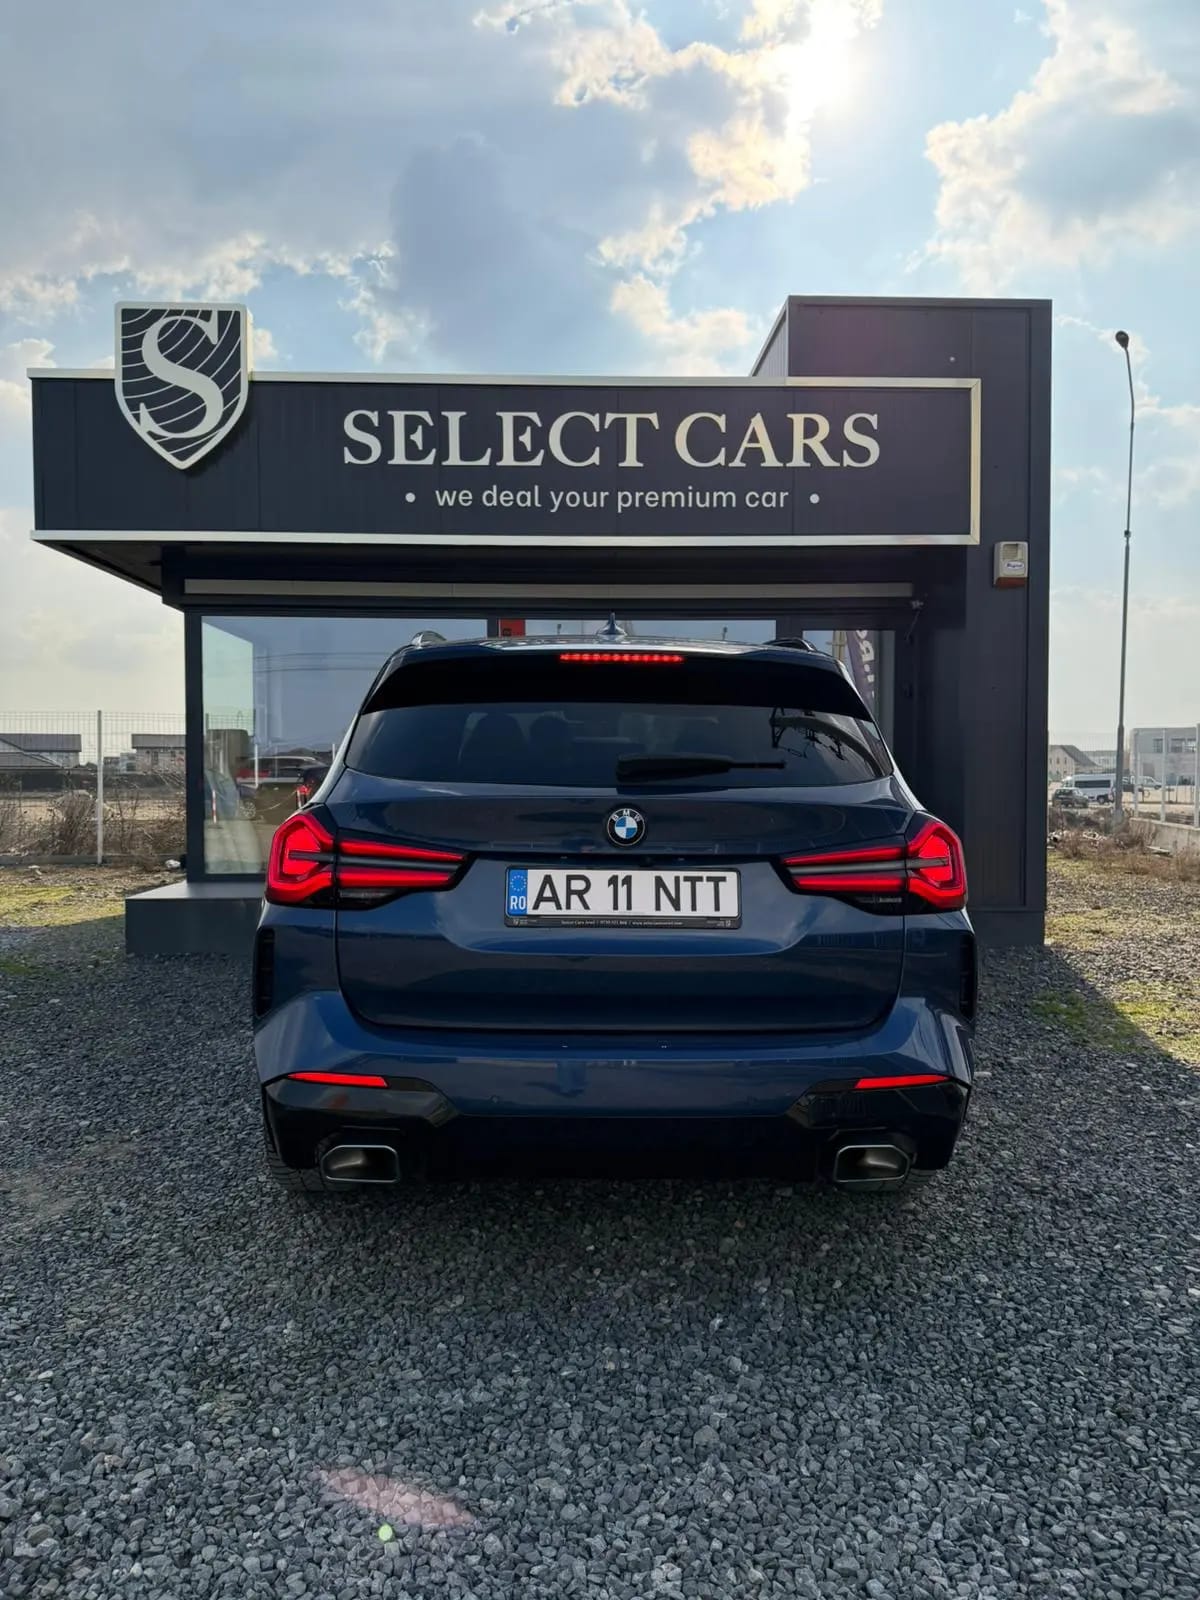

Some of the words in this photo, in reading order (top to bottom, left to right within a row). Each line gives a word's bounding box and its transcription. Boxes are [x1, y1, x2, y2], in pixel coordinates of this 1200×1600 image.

[140, 309, 224, 438] S
[343, 410, 659, 467] SELECT
[675, 412, 880, 467] CARS
[435, 489, 473, 506] we
[482, 485, 542, 507] deal
[550, 490, 609, 513] your
[618, 486, 736, 513] premium
[745, 490, 789, 507] car
[611, 809, 641, 821] BMW
[510, 895, 526, 910] RO
[532, 874, 591, 911] AR
[607, 874, 632, 911] 11
[654, 875, 727, 912] NTT
